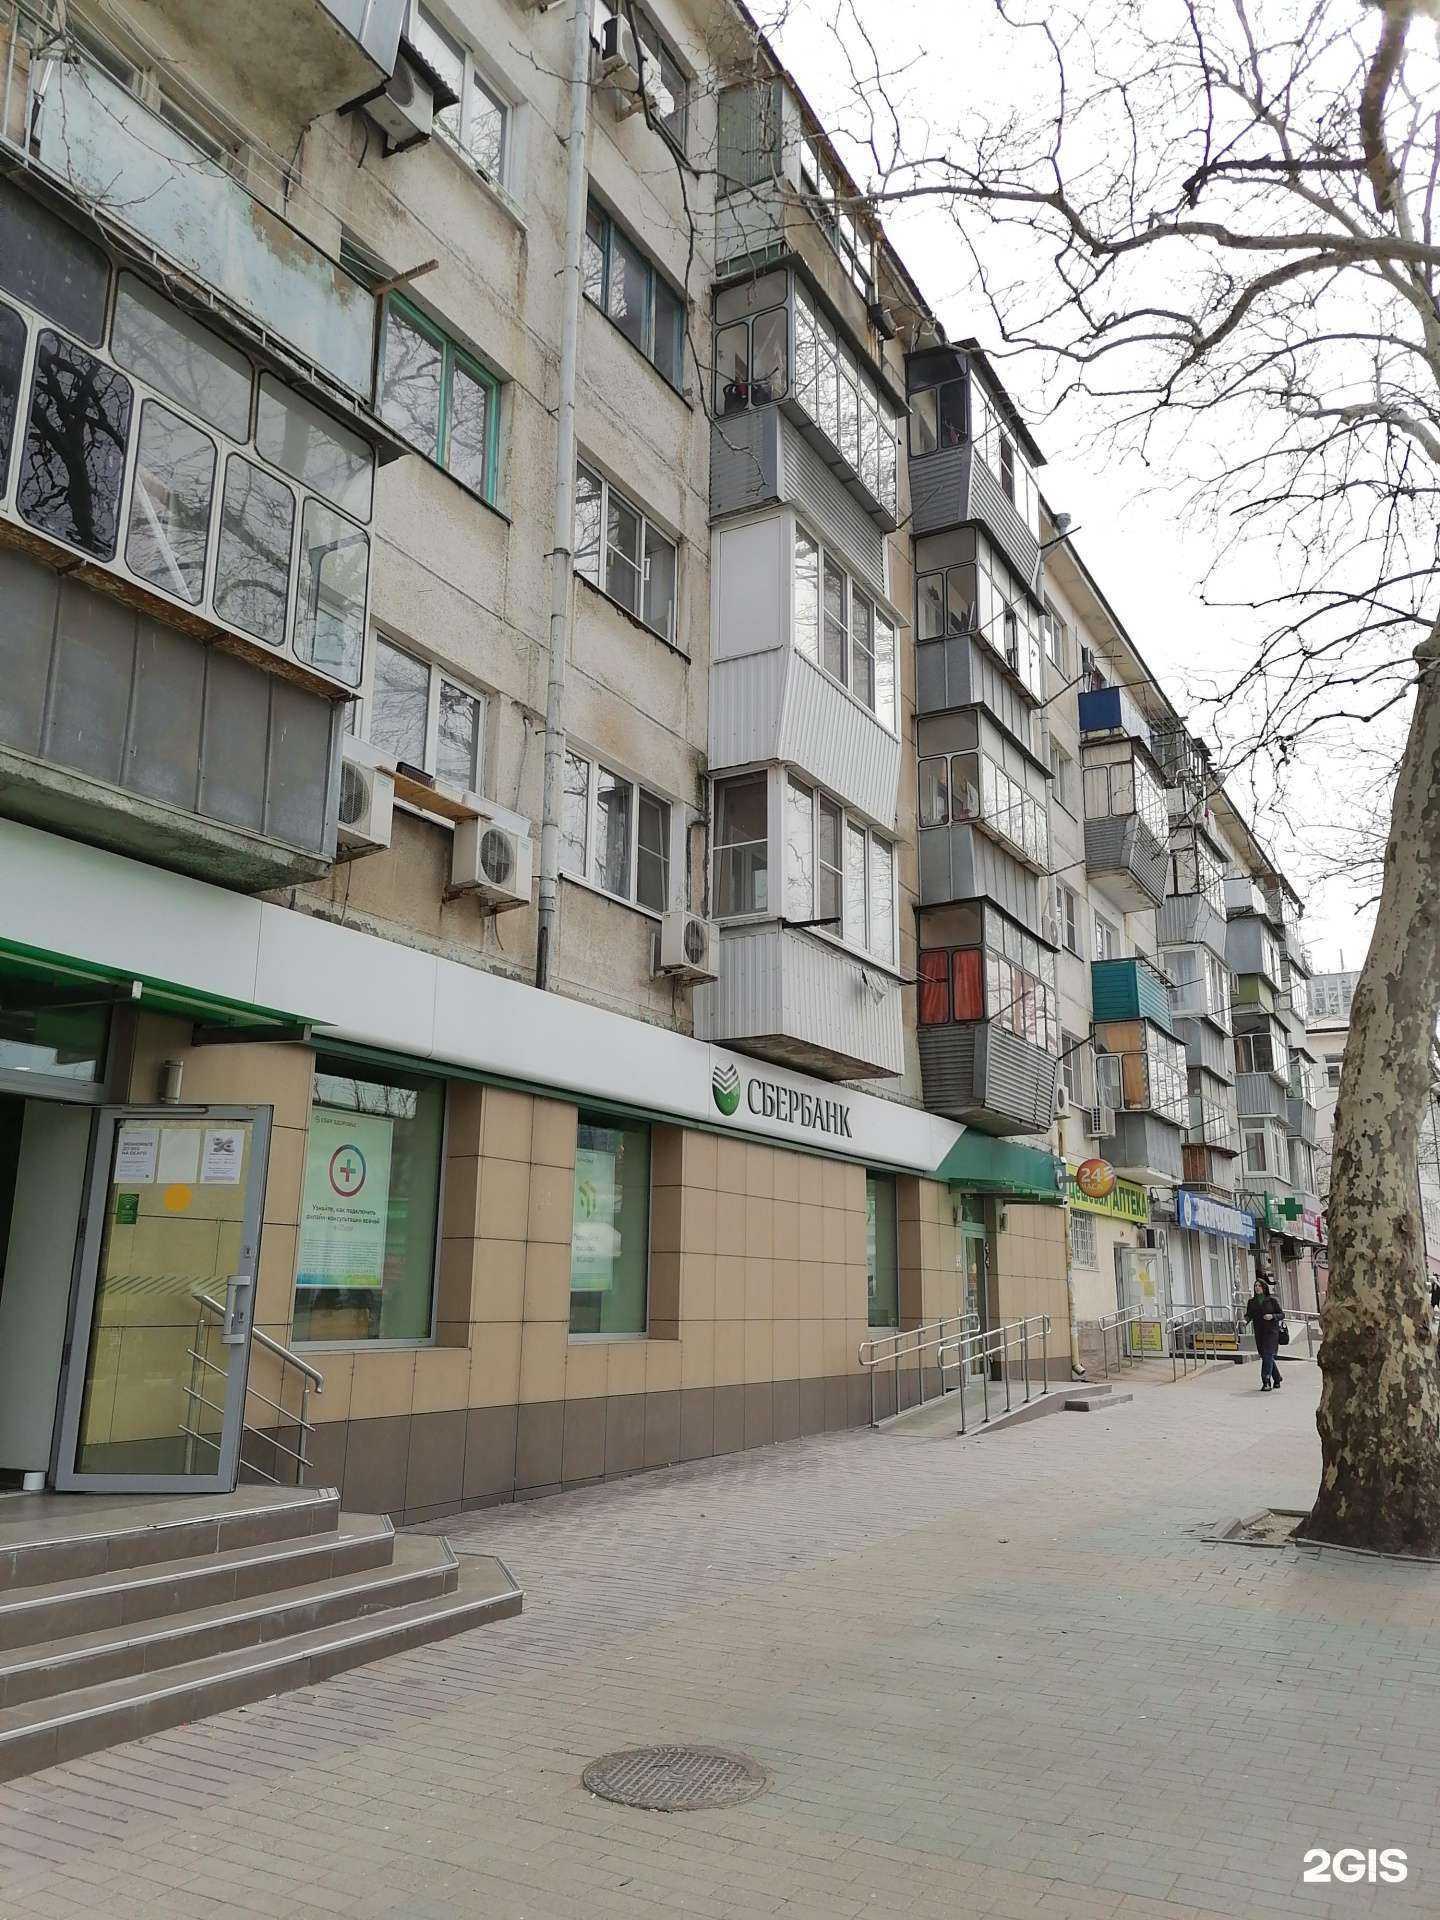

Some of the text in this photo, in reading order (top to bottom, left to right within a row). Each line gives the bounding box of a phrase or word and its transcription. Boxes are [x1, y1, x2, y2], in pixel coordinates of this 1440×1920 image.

[748, 1078, 852, 1138] СБЕРБАНК
[1081, 1167, 1103, 1183] 24
[1113, 1185, 1147, 1218] АПТЕКА
